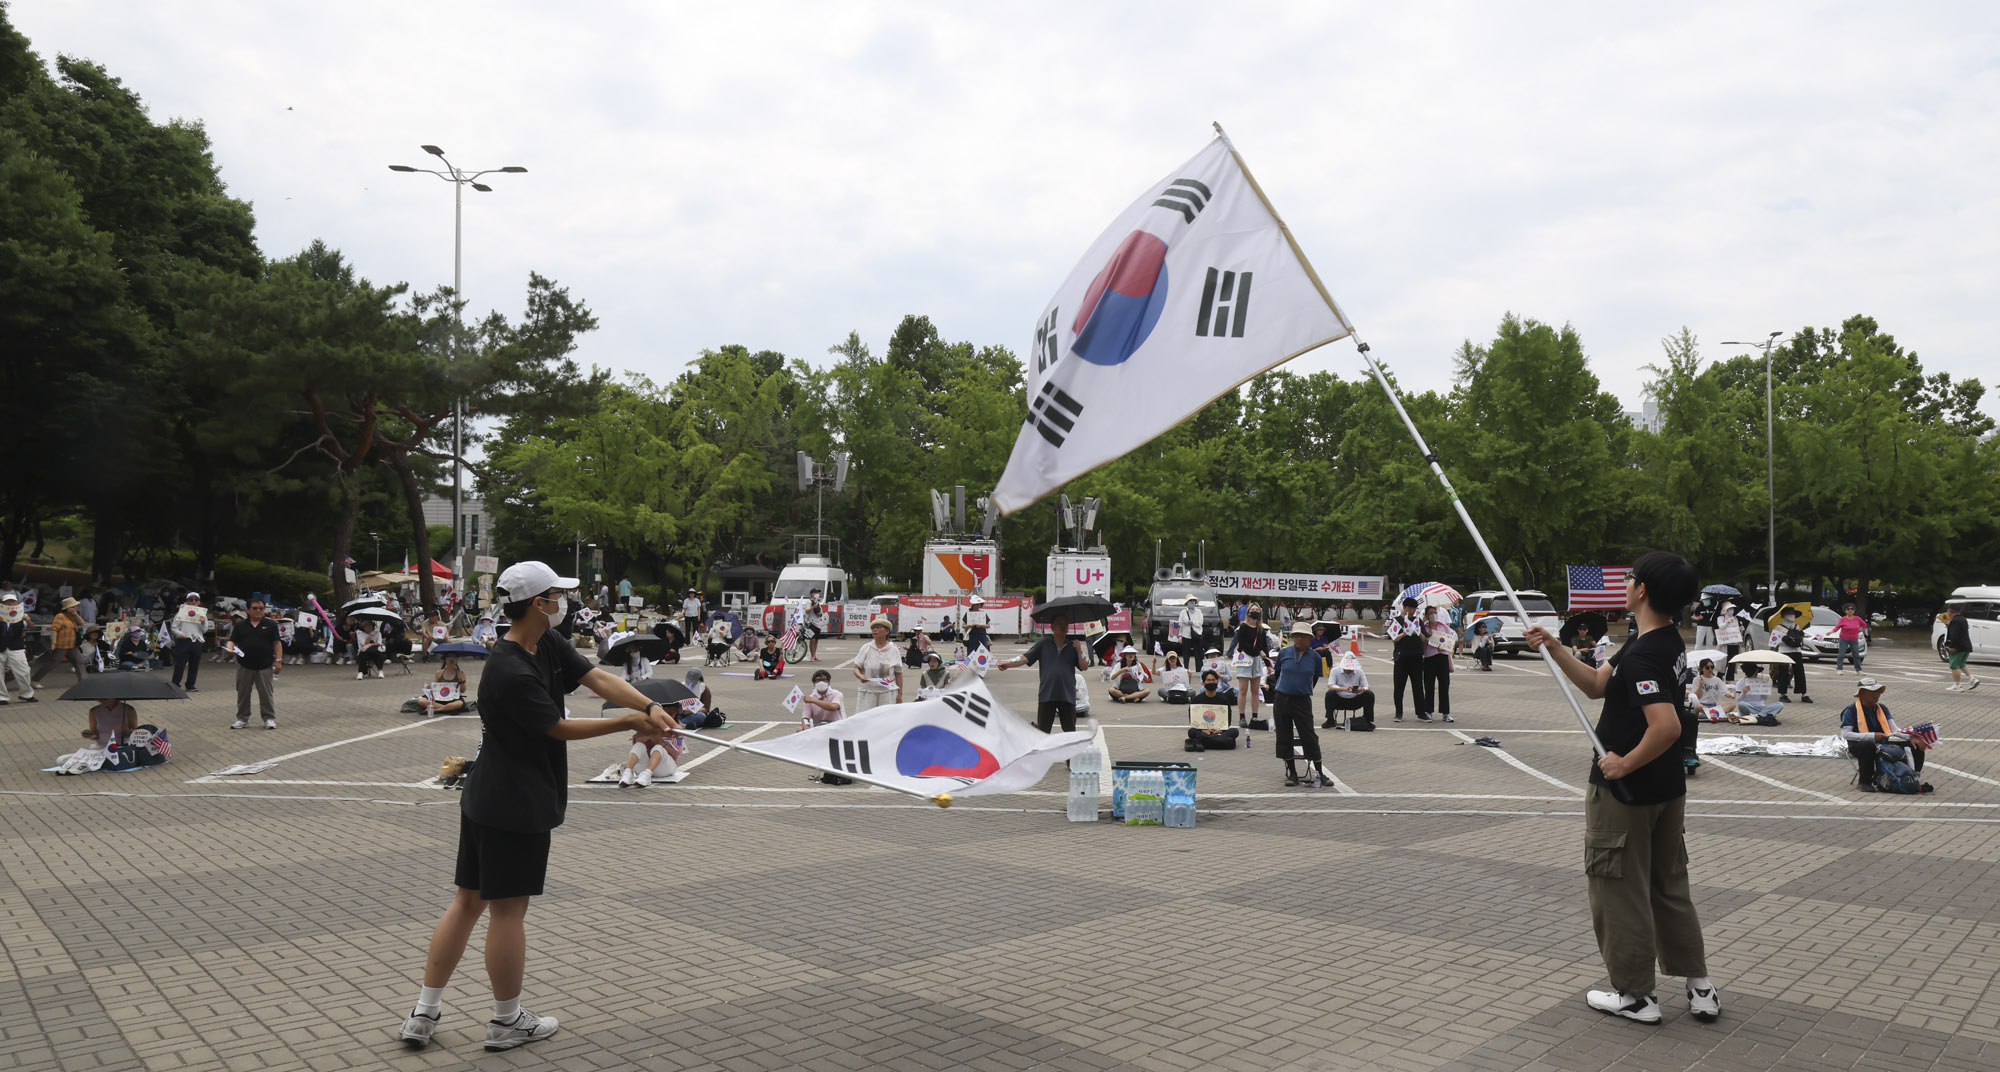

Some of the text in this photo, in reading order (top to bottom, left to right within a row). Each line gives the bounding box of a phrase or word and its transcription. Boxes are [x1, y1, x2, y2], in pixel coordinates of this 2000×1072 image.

[1077, 568, 1104, 585] U+
[1241, 577, 1275, 590] 재선거!
[1278, 578, 1318, 592] 당일투표
[1321, 580, 1354, 593] 수개표!
